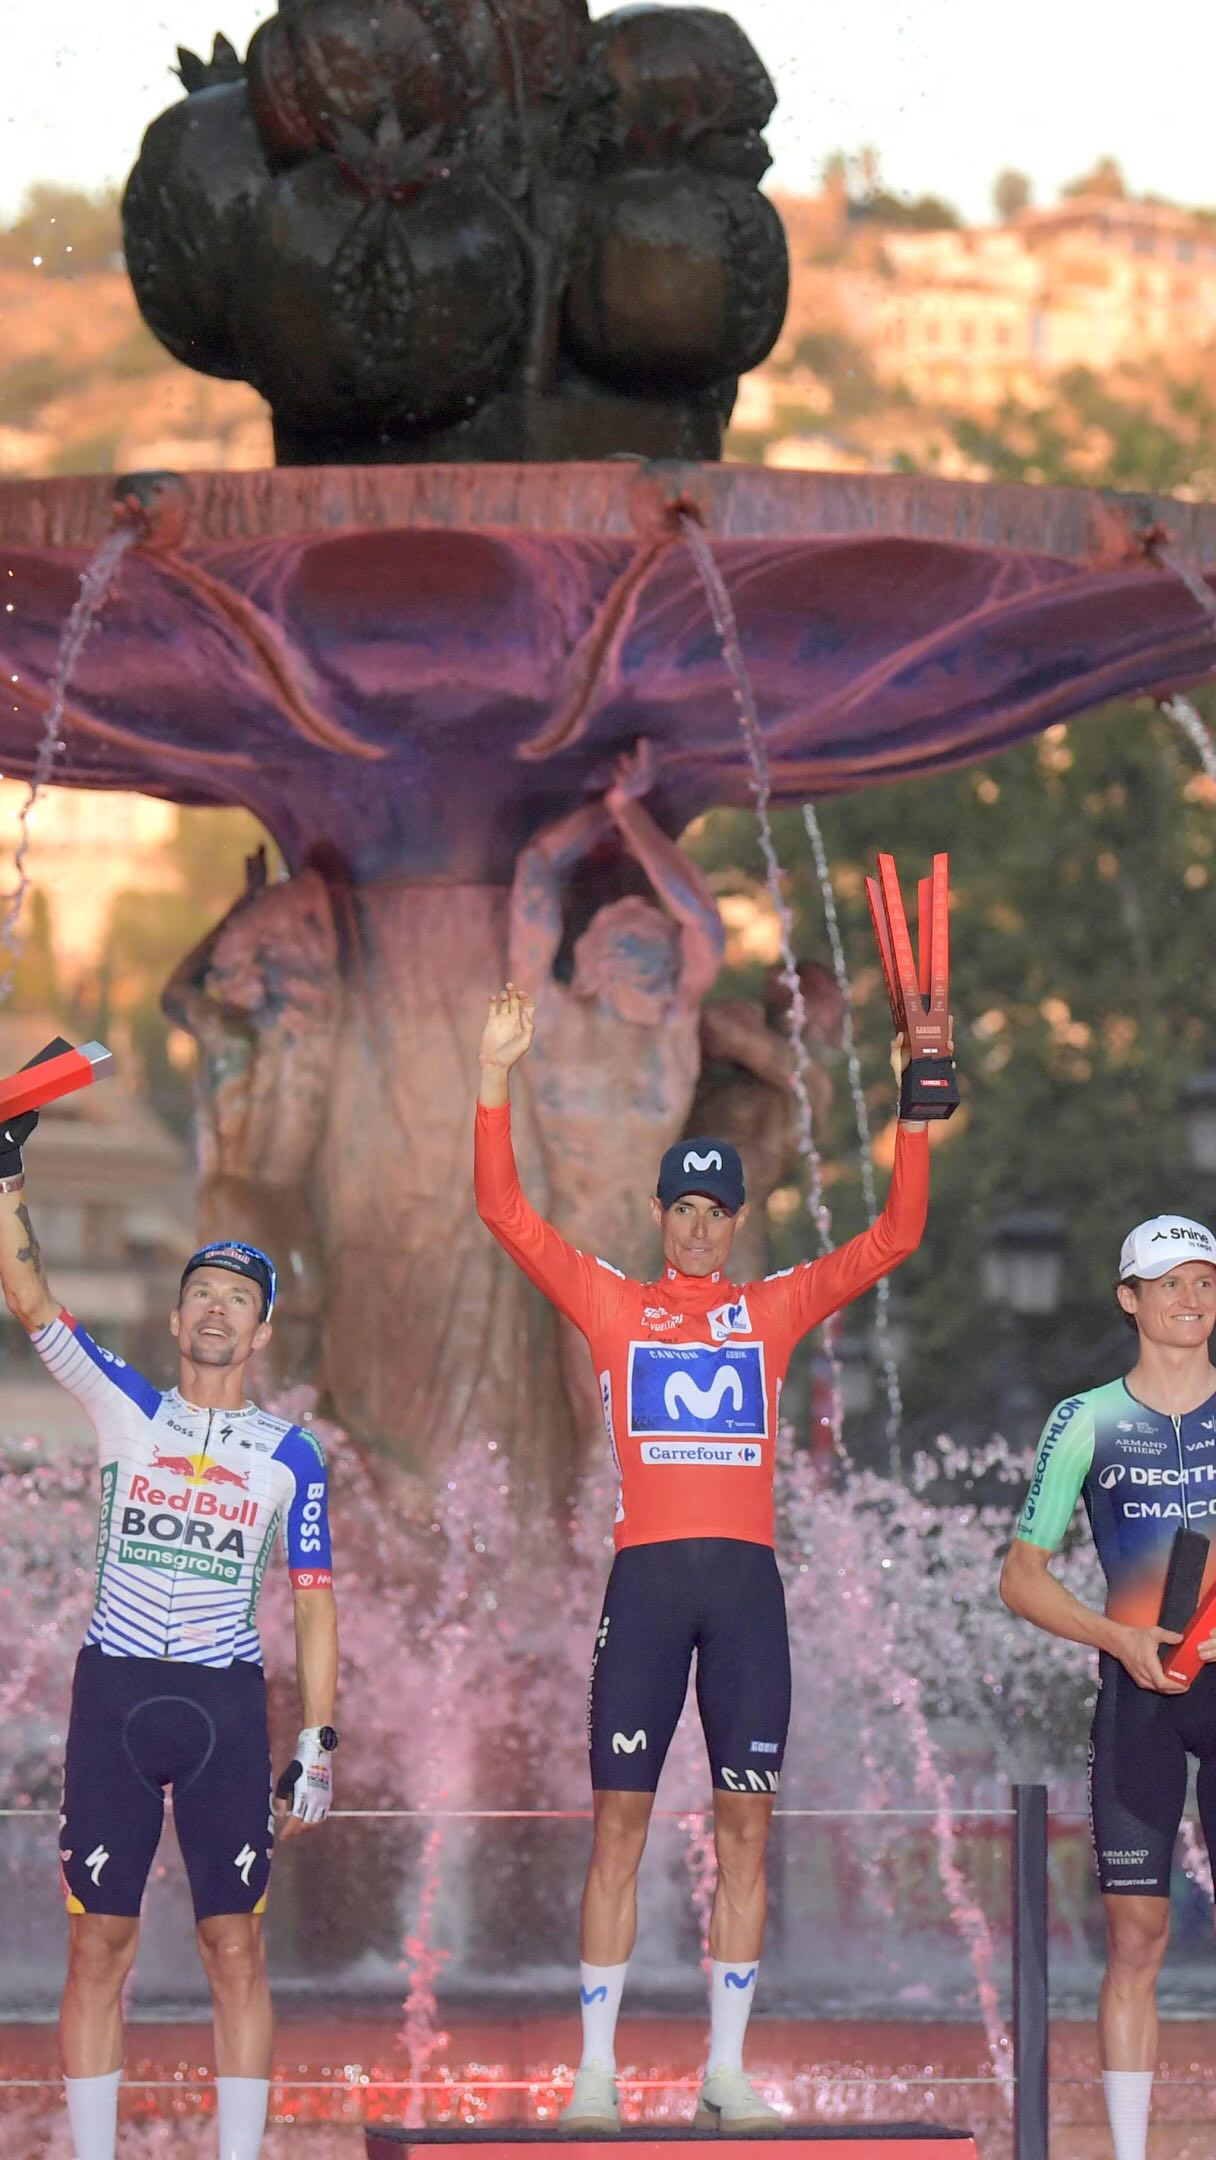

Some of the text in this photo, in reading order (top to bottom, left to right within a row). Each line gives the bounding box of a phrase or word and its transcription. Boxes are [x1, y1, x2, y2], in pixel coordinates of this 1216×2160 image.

[1170, 1227, 1209, 1244] Shine
[649, 1350, 699, 1360] CANYON
[166, 1419, 194, 1437] BOSS
[1031, 1398, 1085, 1496] DECATHLON
[1115, 1439, 1168, 1450] ARMAND
[1121, 1445, 1162, 1455] THIERY
[1185, 1439, 1215, 1451] VAN
[649, 1447, 732, 1461] Carrefour
[129, 1474, 258, 1528] Red Bull
[300, 1483, 324, 1552] BOSS
[121, 1507, 245, 1559] BORA
[122, 1540, 237, 1579] hansgrohe
[751, 1741, 779, 1753] GOBIK
[1102, 1850, 1149, 1858] ARMAND
